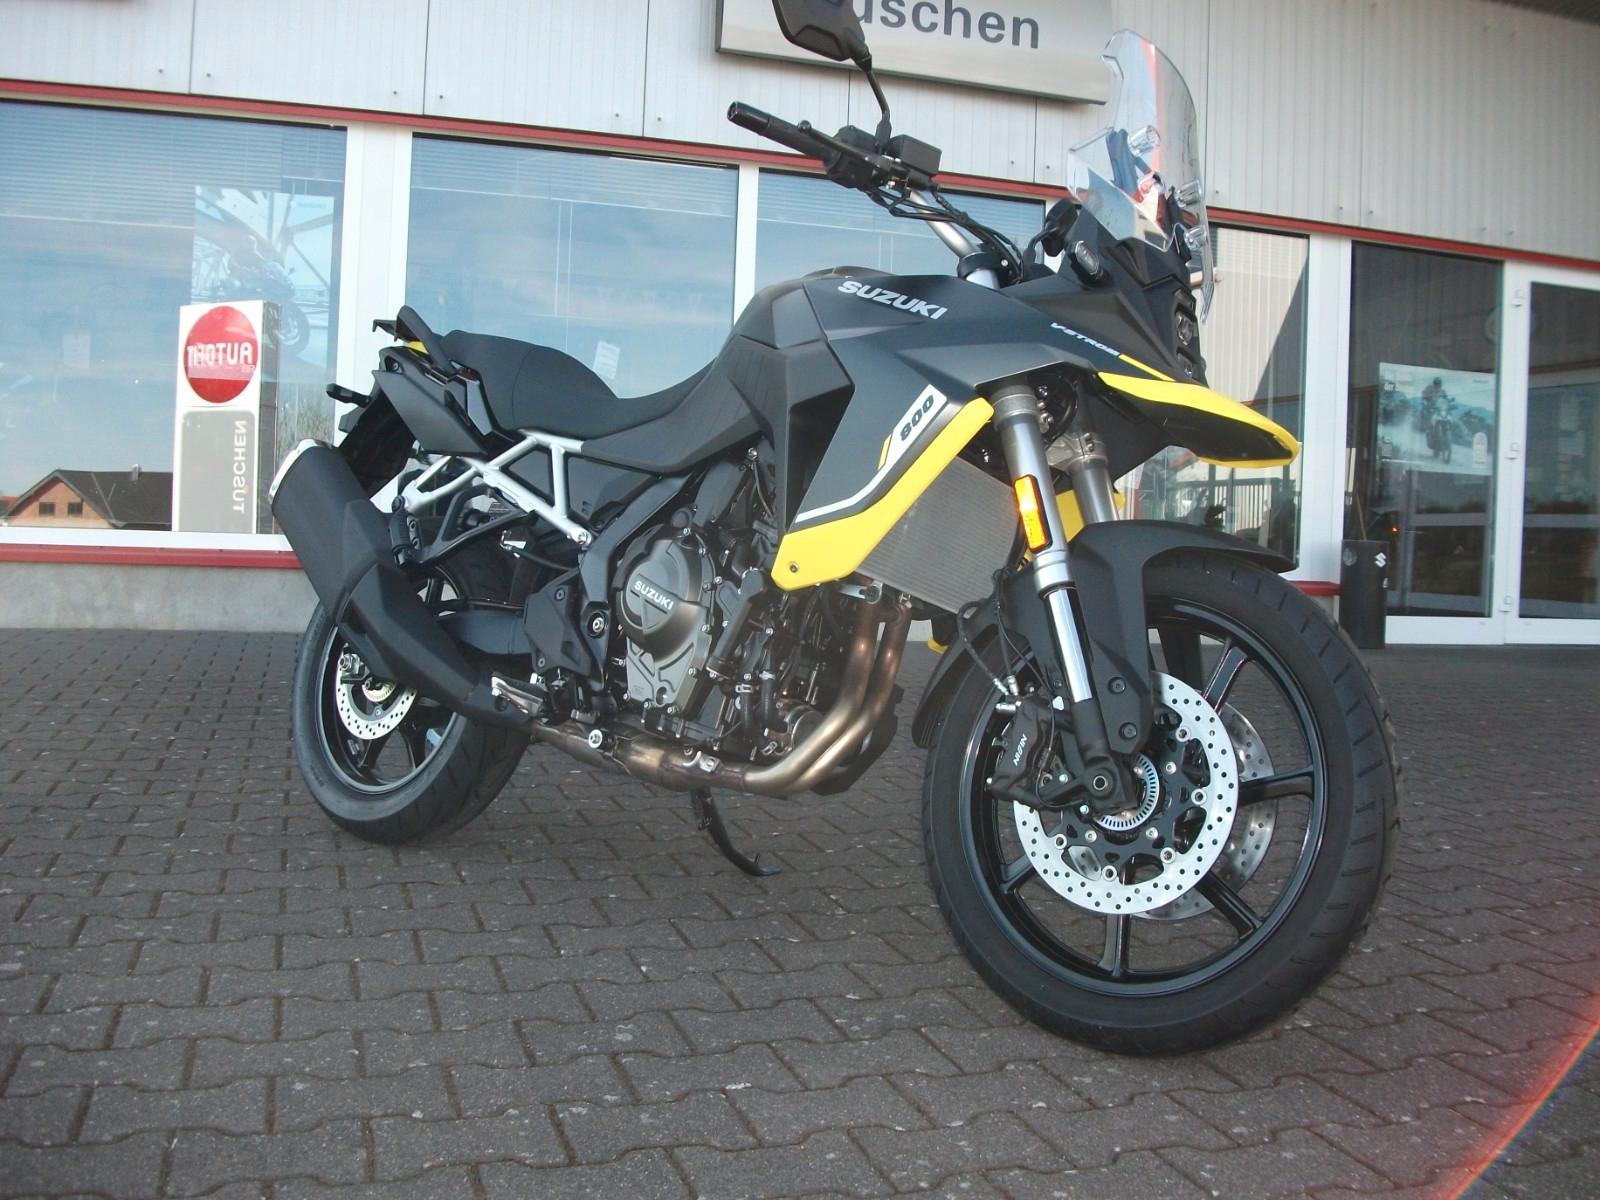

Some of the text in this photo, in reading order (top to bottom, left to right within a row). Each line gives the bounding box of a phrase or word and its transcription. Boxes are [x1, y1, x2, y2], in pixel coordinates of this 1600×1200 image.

[851, 0, 1040, 49] uschen
[837, 280, 949, 321] SUZUKI
[900, 395, 935, 442] 800
[633, 580, 675, 611] SUZUKI
